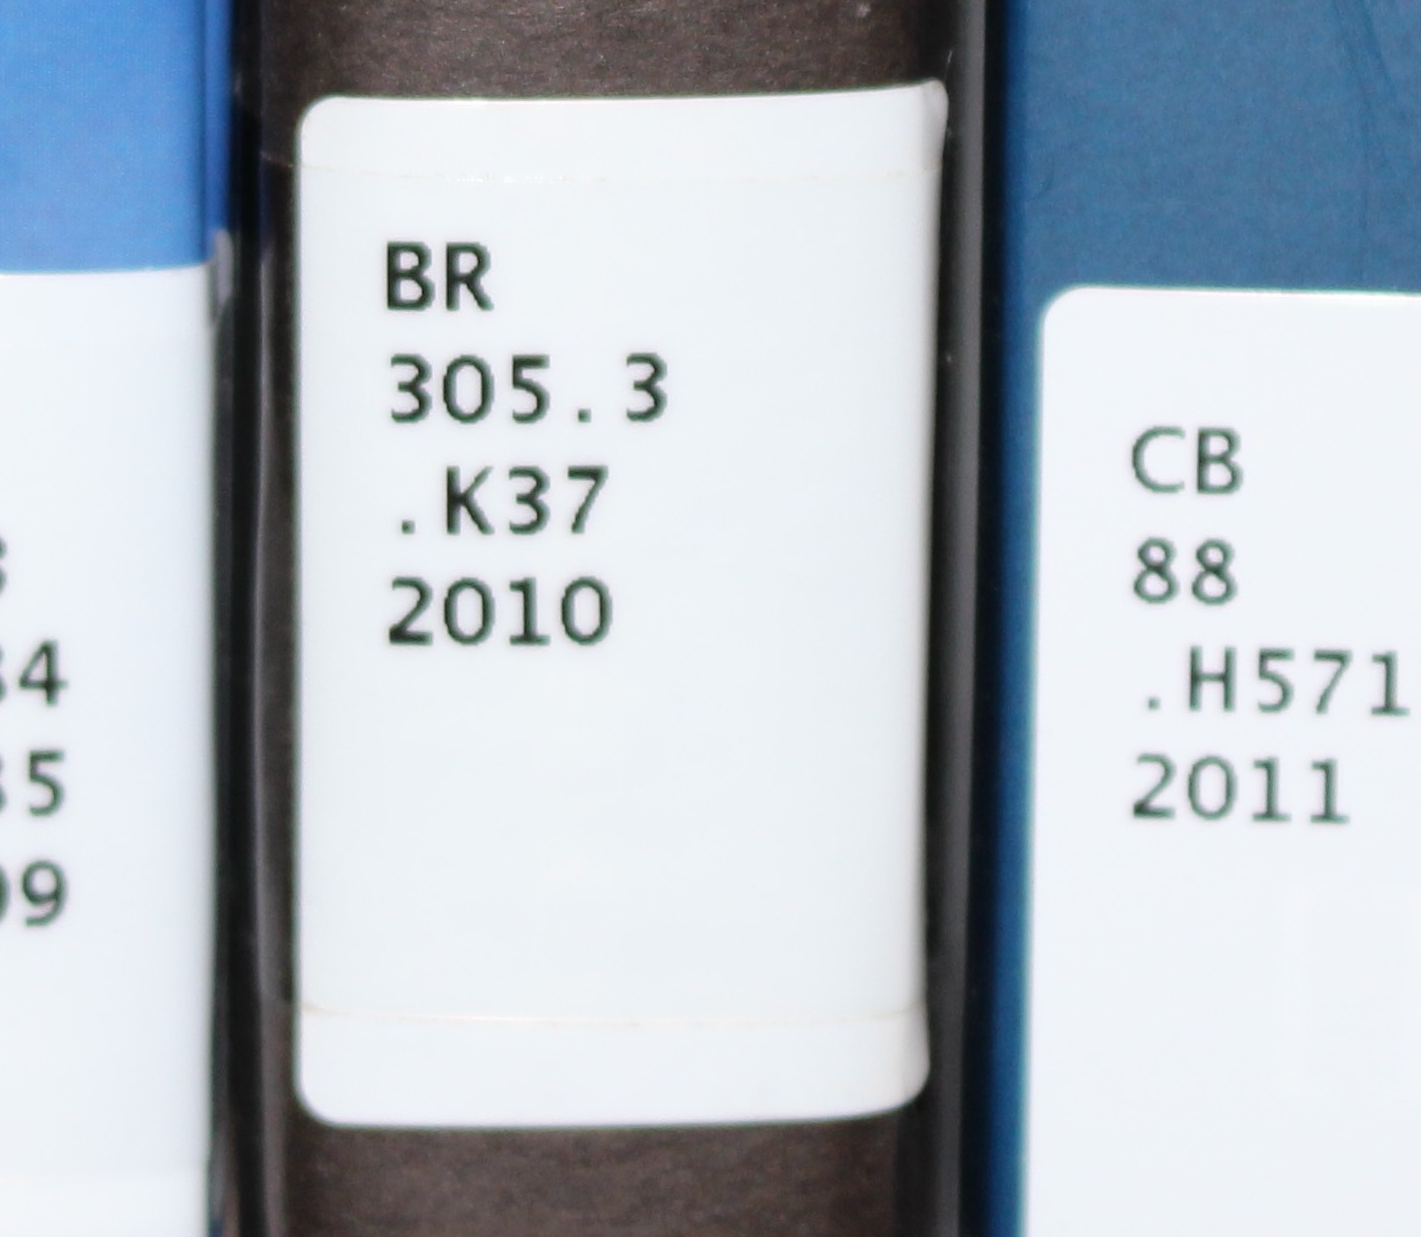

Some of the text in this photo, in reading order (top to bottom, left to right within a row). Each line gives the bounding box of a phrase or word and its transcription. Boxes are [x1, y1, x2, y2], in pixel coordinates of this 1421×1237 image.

[383, 239, 495, 313] BR
[389, 351, 668, 426] 305.3
[1129, 424, 1244, 497] CB
[399, 463, 610, 537] .K37
[1131, 536, 1239, 607] 88
[386, 574, 614, 648] 2010
[1130, 751, 1350, 826] 2011
